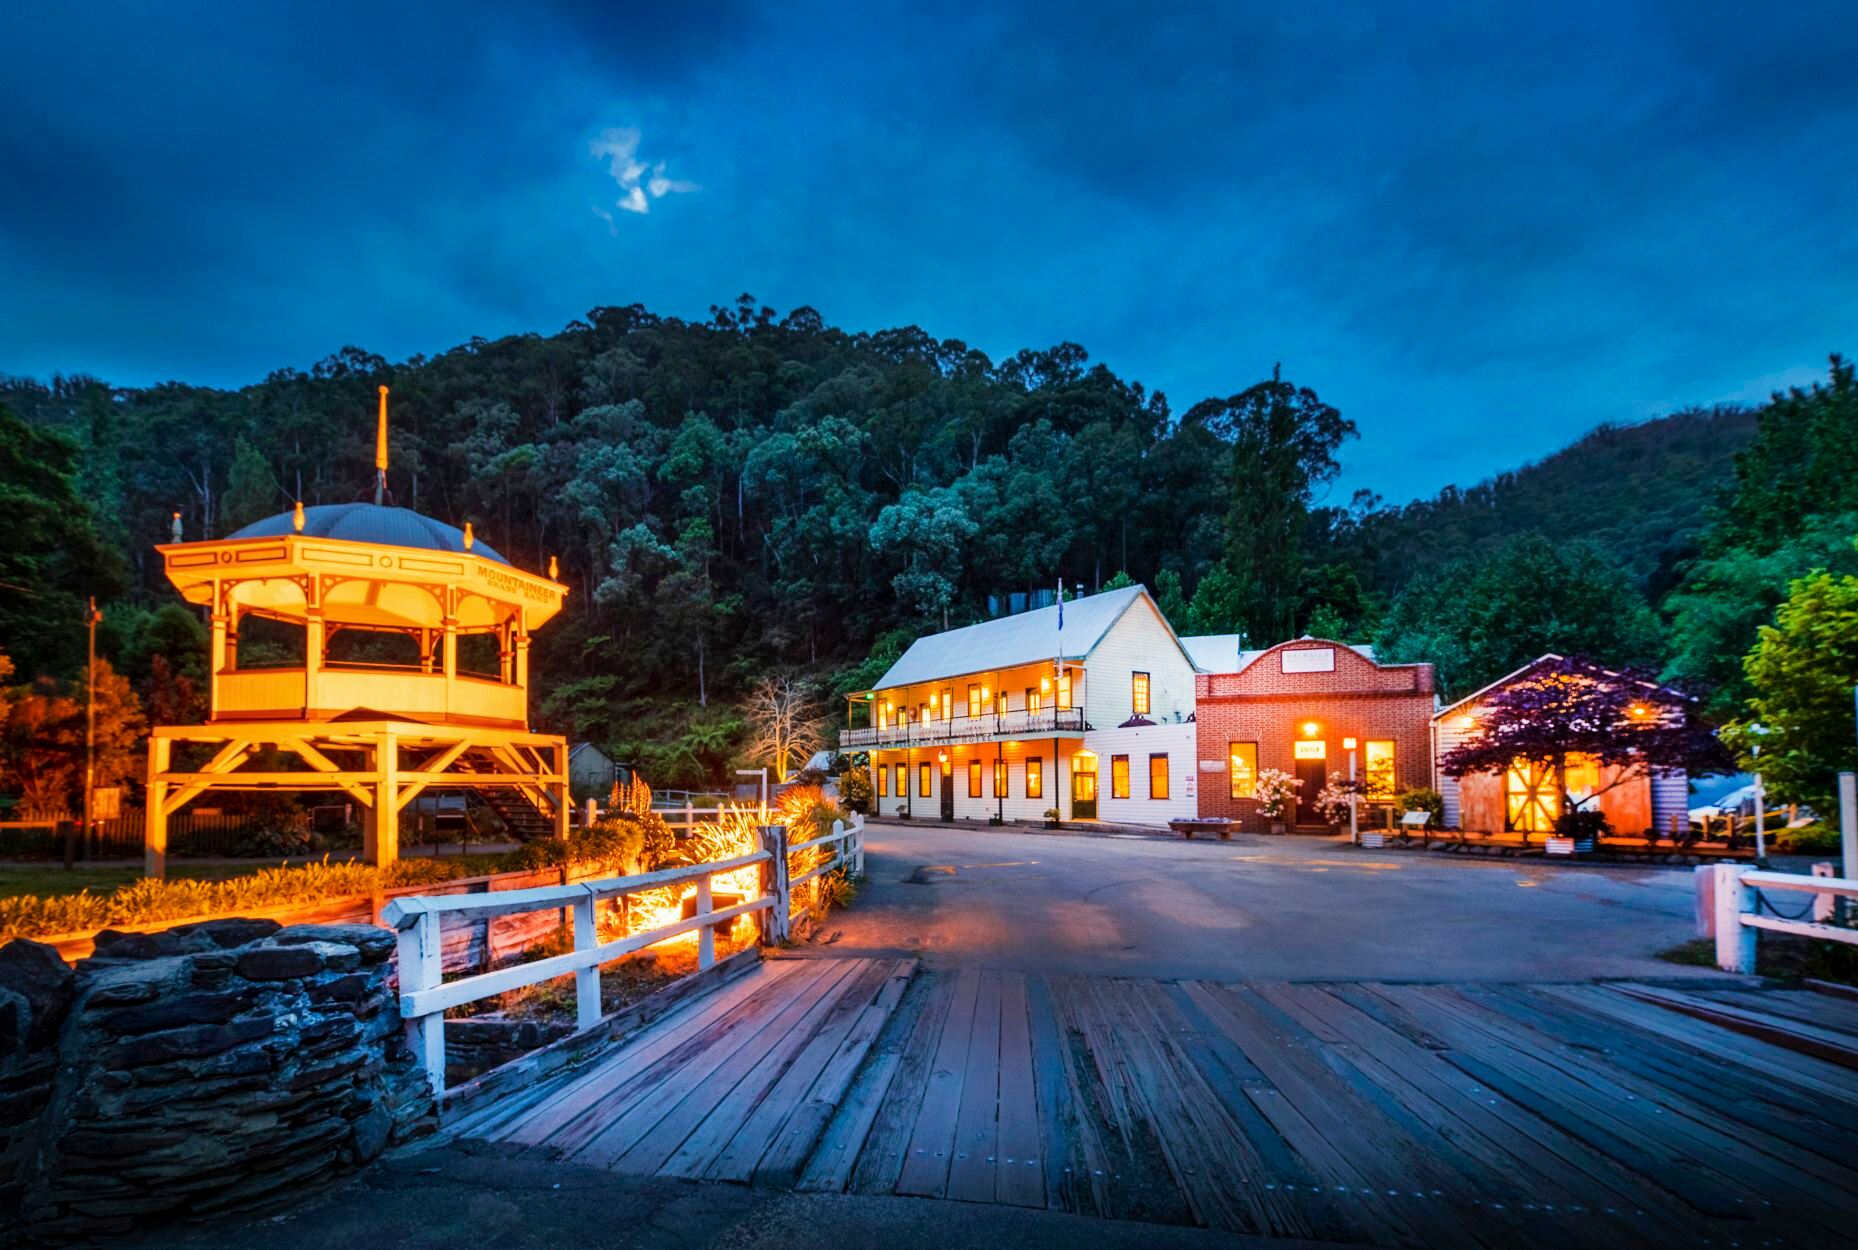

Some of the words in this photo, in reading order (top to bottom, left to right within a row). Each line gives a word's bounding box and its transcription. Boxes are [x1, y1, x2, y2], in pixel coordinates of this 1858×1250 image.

[478, 566, 556, 600] MOUNTAINEER
[487, 580, 517, 594] BRASS
[962, 735, 993, 744] HOTEL
